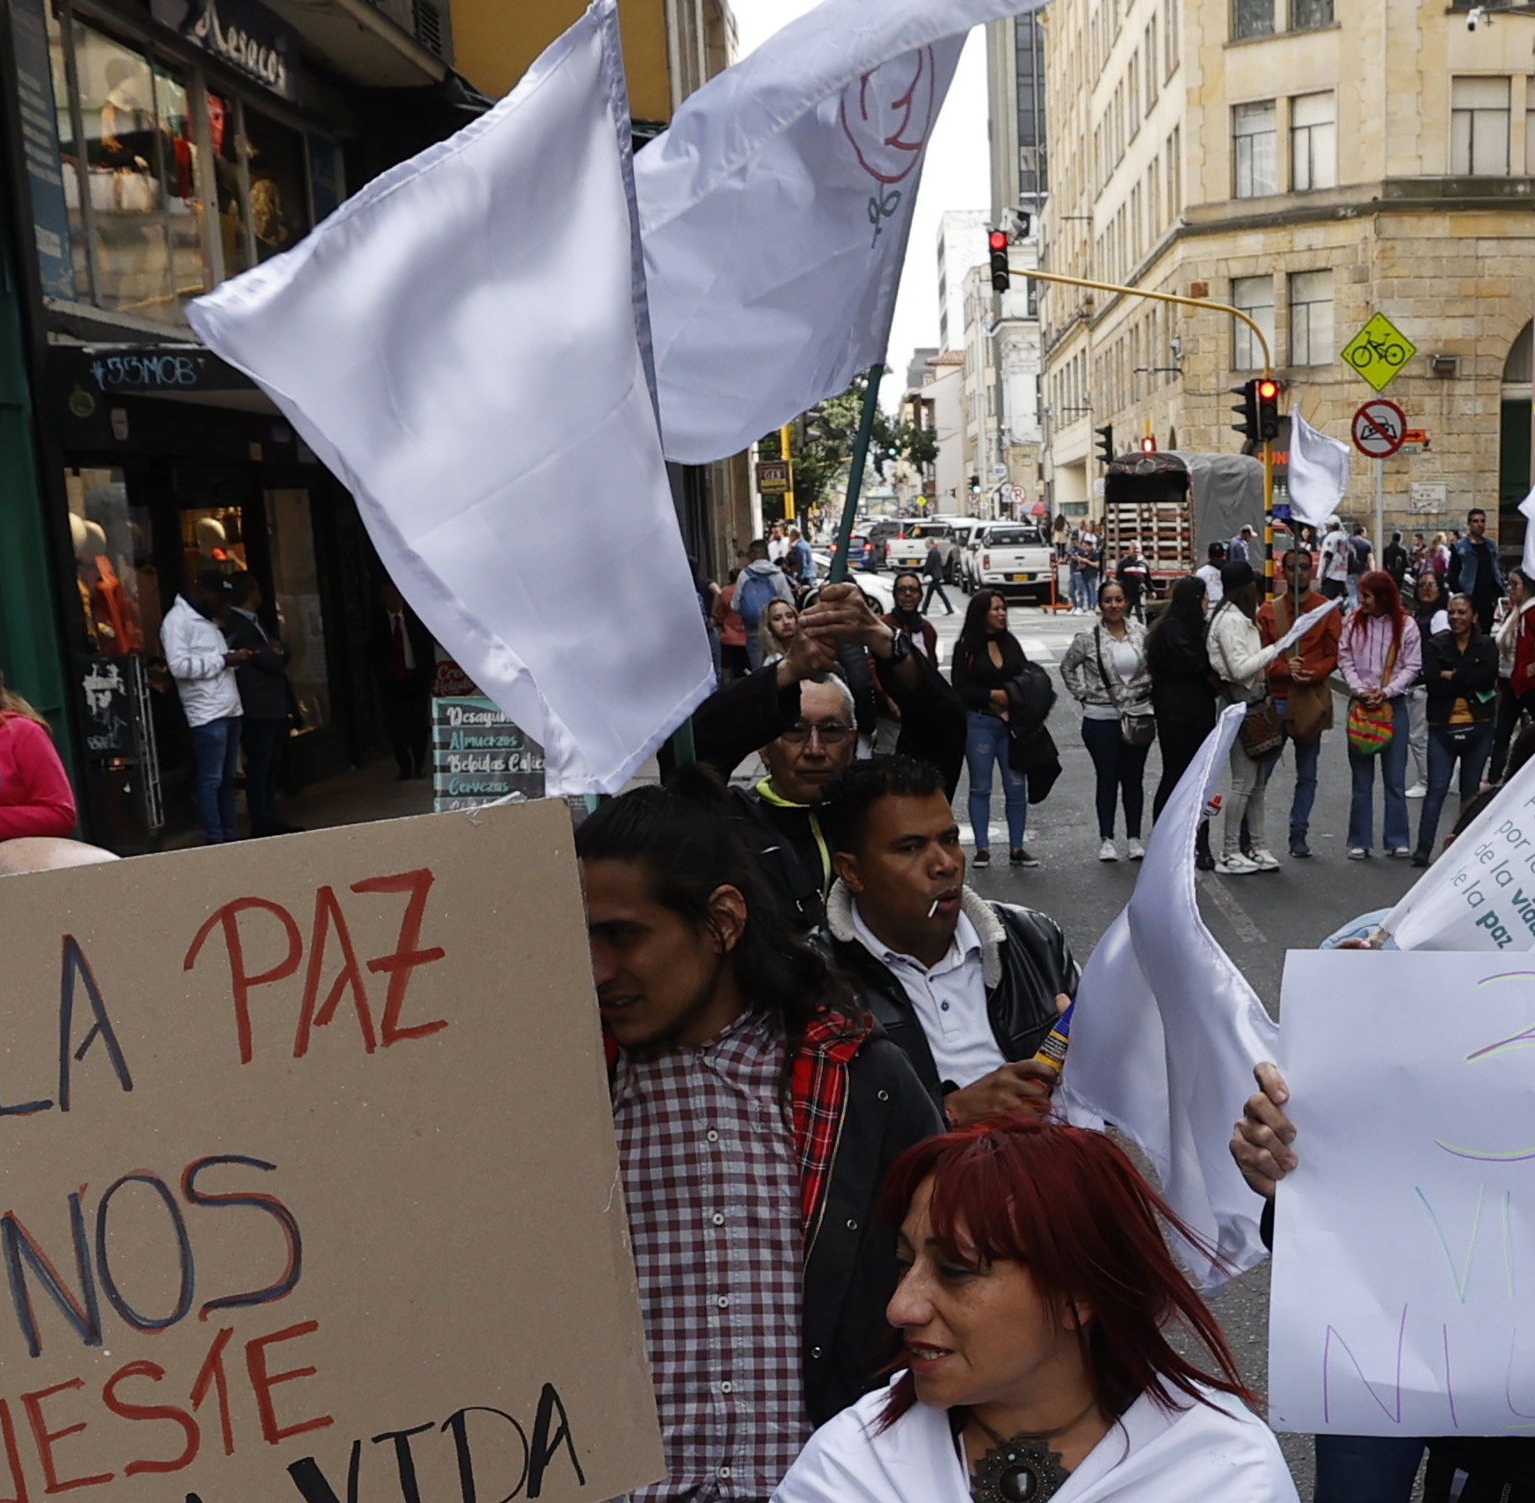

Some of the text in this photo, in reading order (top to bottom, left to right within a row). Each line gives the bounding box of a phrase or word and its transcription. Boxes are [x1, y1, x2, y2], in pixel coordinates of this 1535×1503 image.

[1490, 859, 1514, 888] la
[1493, 819, 1531, 850] por
[1461, 880, 1486, 909] la
[1475, 910, 1514, 949] paz
[183, 868, 450, 1066] PAZ
[0, 1155, 304, 1359] NOS
[1322, 1303, 1462, 1430] NI
